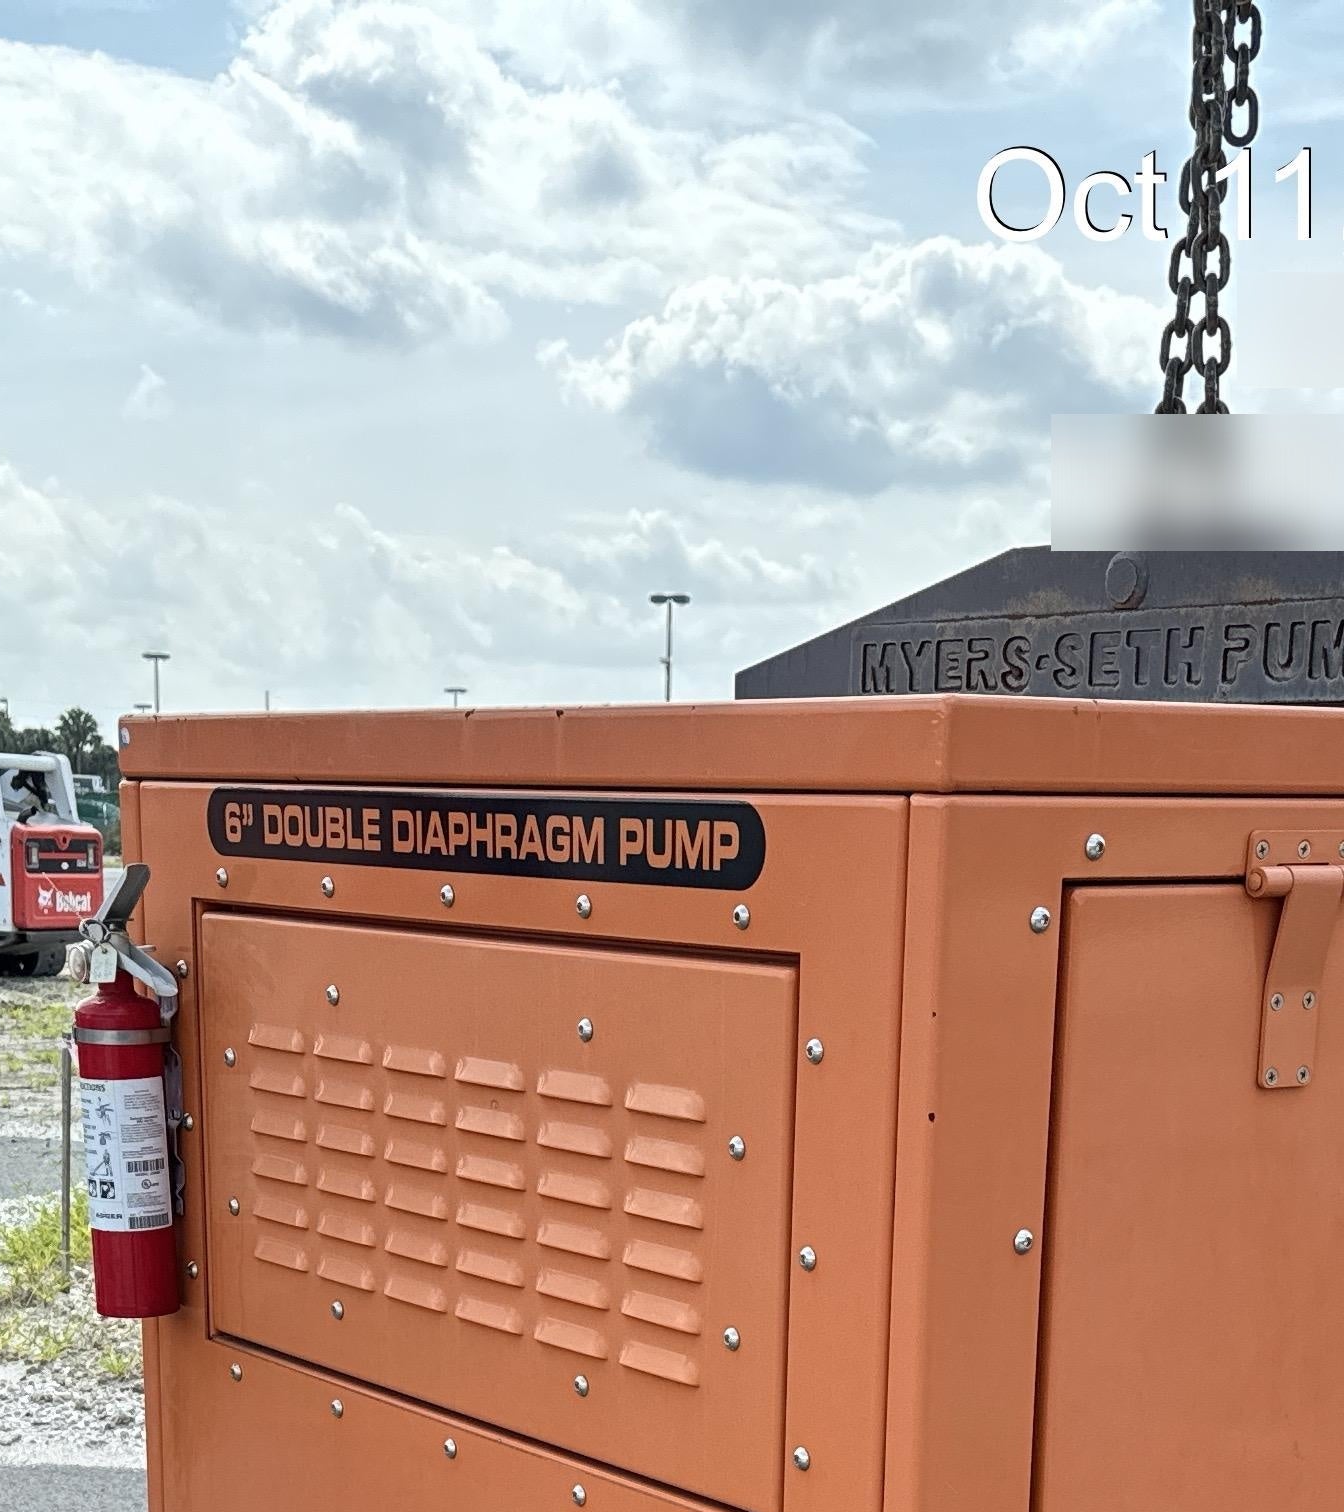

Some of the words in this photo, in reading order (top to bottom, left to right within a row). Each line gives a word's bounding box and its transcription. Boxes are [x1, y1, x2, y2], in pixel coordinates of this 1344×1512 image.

[262, 803, 382, 852] DOUBLE
[391, 808, 606, 866] DIAPHRAGM
[618, 816, 740, 872] PUMP
[56, 890, 91, 912] Bobcat
